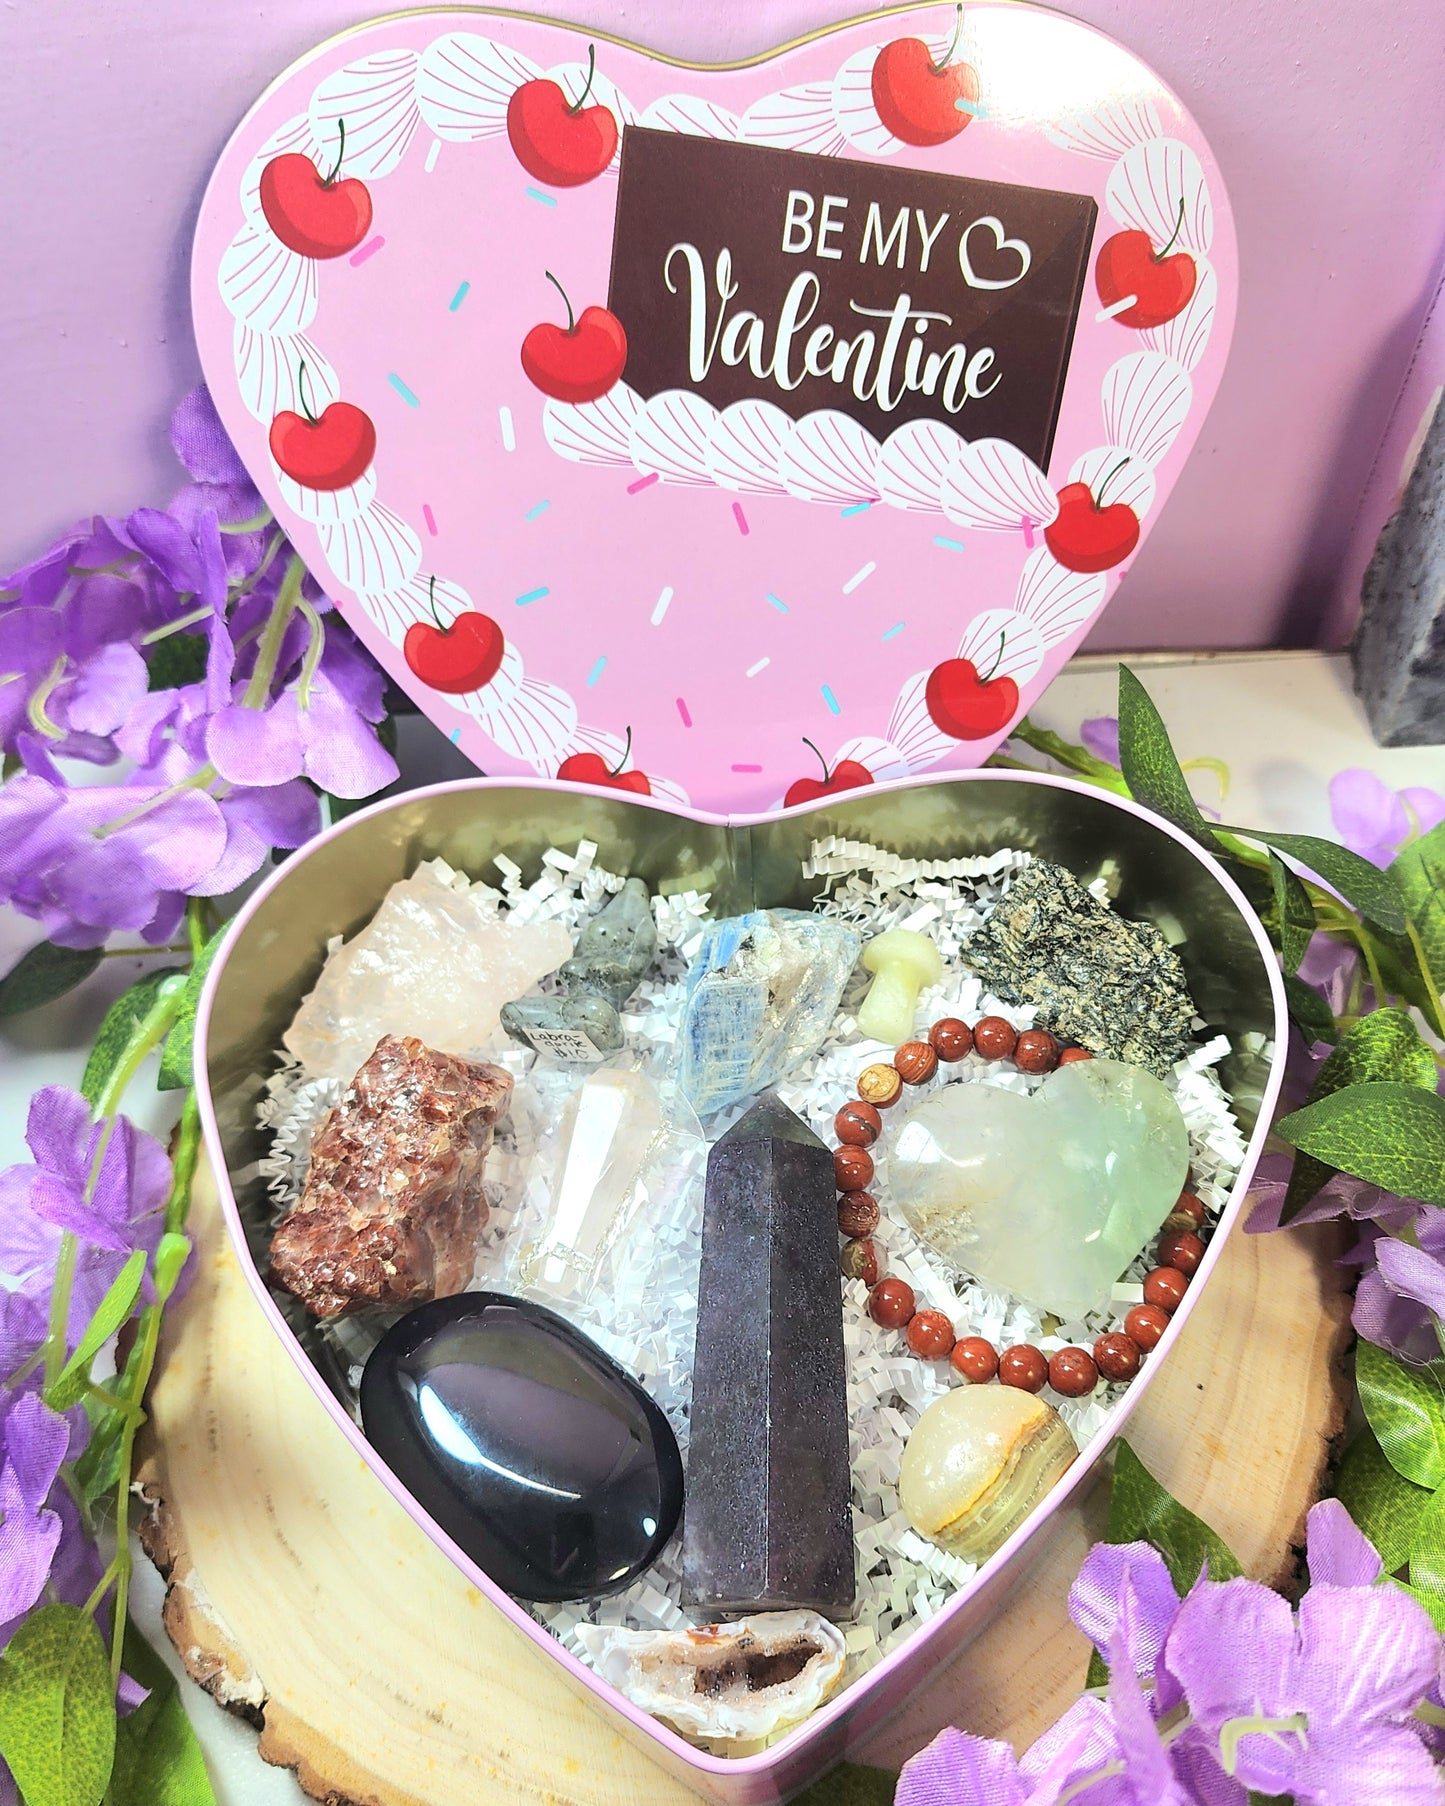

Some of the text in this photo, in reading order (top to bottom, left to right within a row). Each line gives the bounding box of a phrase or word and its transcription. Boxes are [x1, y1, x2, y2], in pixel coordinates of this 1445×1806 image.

[782, 190, 950, 273] BE MY
[664, 242, 1003, 414] Valentine
[530, 1031, 580, 1041] Labra-
